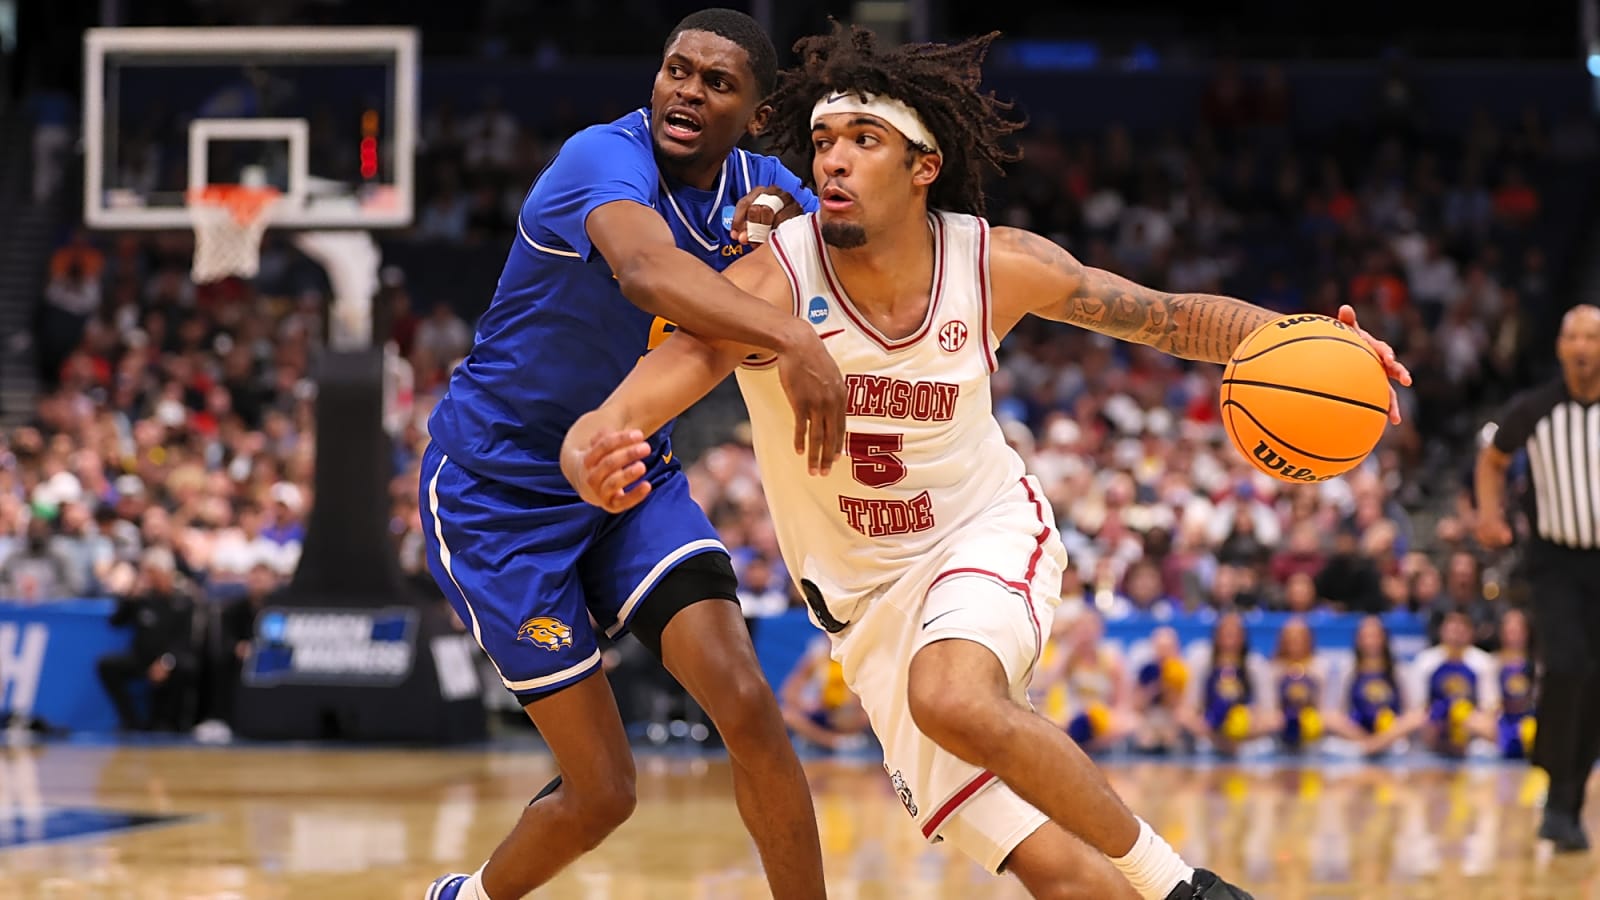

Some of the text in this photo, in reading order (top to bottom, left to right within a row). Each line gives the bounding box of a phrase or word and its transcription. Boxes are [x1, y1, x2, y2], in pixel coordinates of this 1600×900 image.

[721, 244, 744, 257] CAA
[810, 308, 828, 318] NCAA
[940, 322, 967, 350] SEC
[845, 374, 959, 422] IMSON
[846, 432, 908, 489] 5
[1253, 440, 1336, 482] Wilso
[838, 490, 935, 537] TIDE
